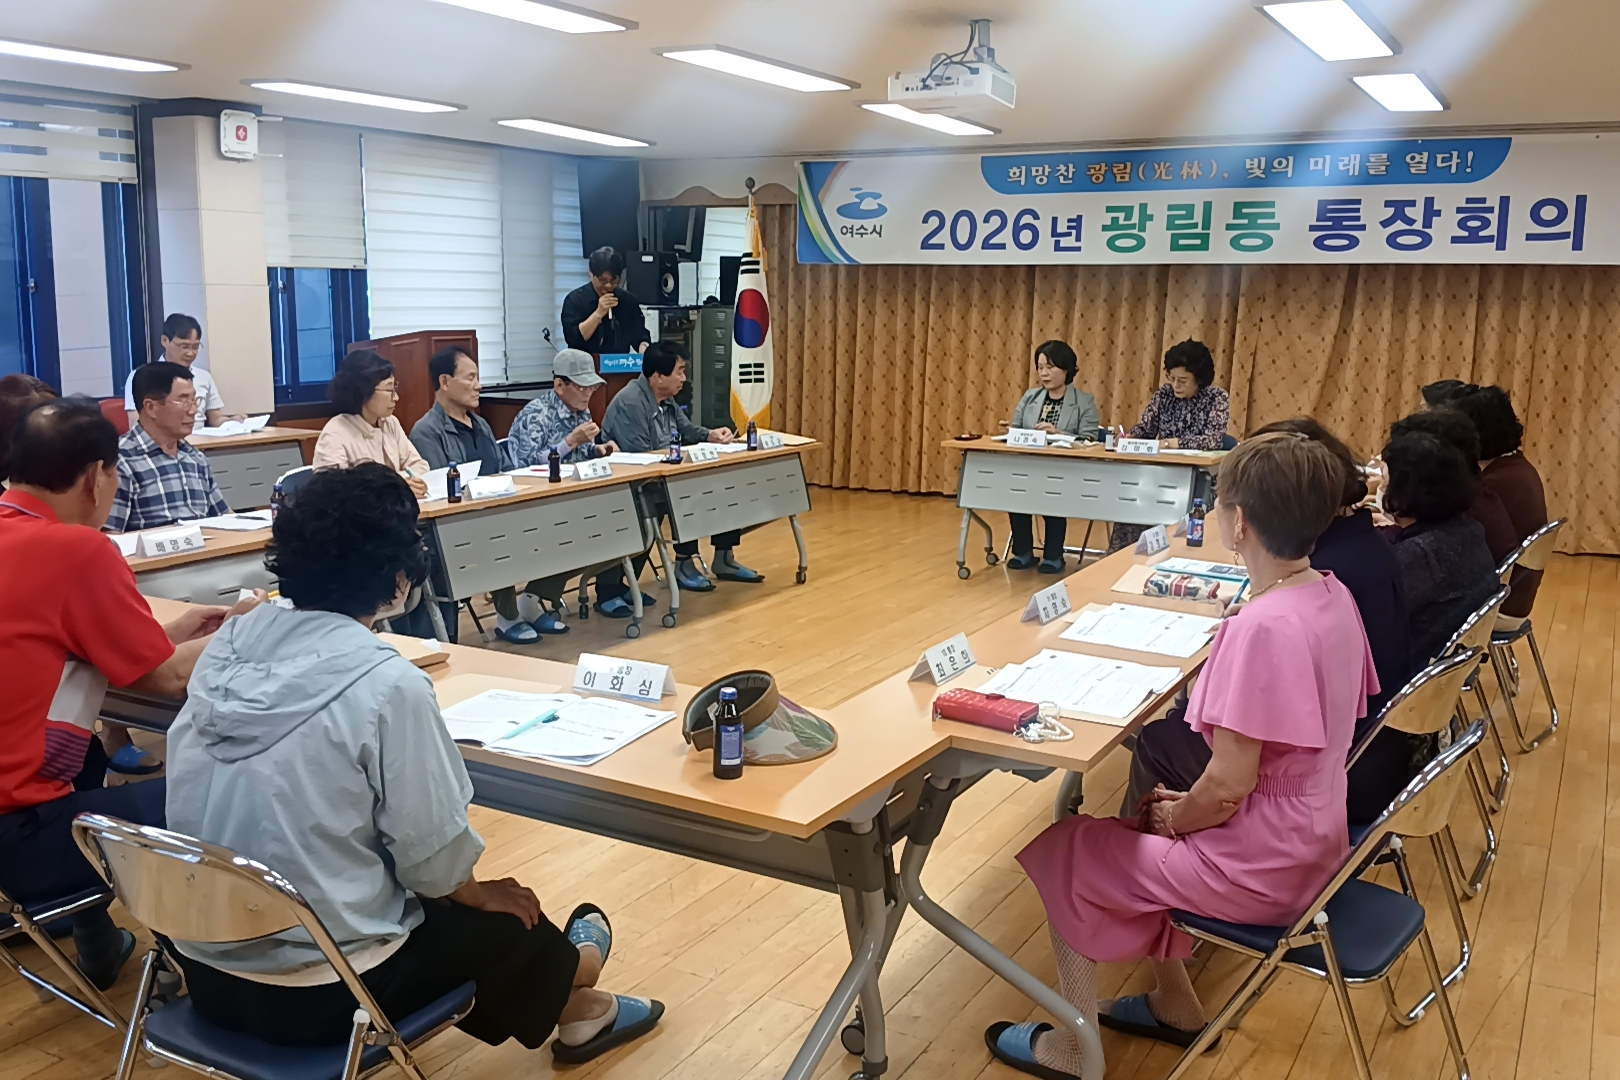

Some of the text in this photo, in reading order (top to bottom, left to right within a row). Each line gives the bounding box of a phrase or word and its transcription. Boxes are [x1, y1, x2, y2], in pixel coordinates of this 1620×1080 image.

[1007, 164, 1076, 186] 희망찬
[1245, 155, 1294, 180] 빛의
[1309, 152, 1391, 177] 미래를
[1405, 150, 1475, 174] 열다!
[840, 223, 884, 239] 여수시
[920, 194, 1588, 253] 2026년 광림동 통장회의
